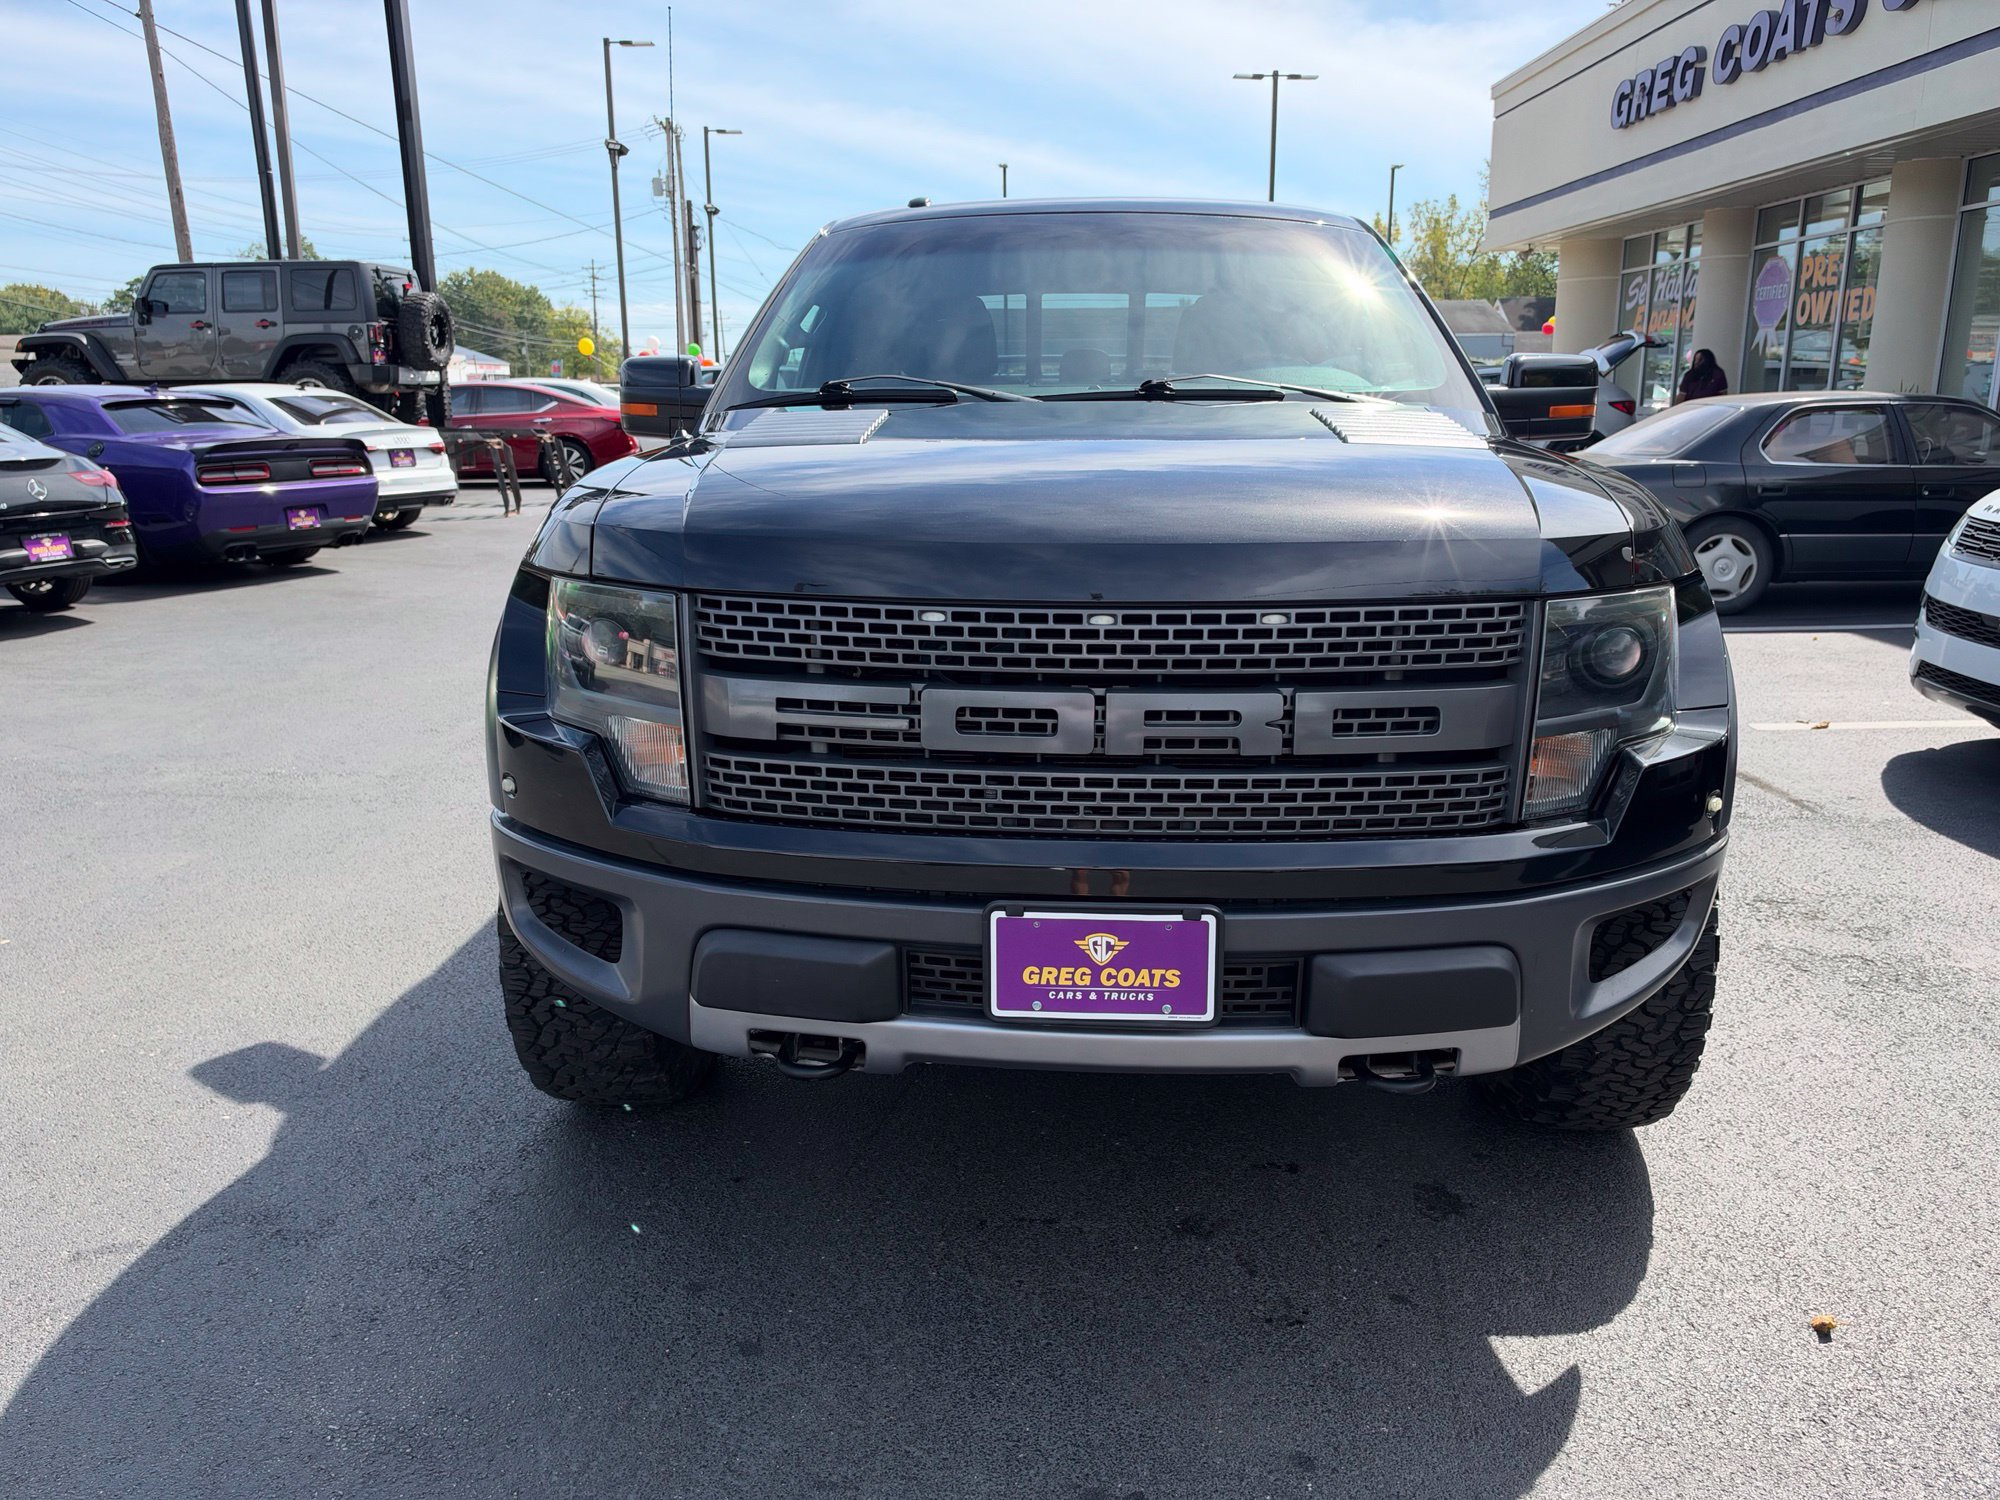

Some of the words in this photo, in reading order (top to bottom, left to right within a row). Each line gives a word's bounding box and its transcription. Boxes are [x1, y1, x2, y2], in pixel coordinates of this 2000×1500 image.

[1611, 46, 1707, 129] GREG
[1626, 275, 1647, 311] Se
[1756, 283, 1788, 300] CERTIFIED
[1796, 286, 1876, 325] OWNED
[702, 673, 1515, 757] FORD
[1022, 966, 1092, 985] GREG
[1099, 968, 1181, 988] COATS
[1048, 991, 1082, 1000] CARS
[1089, 992, 1097, 1000] &
[1103, 992, 1154, 1001] TRUCKS
